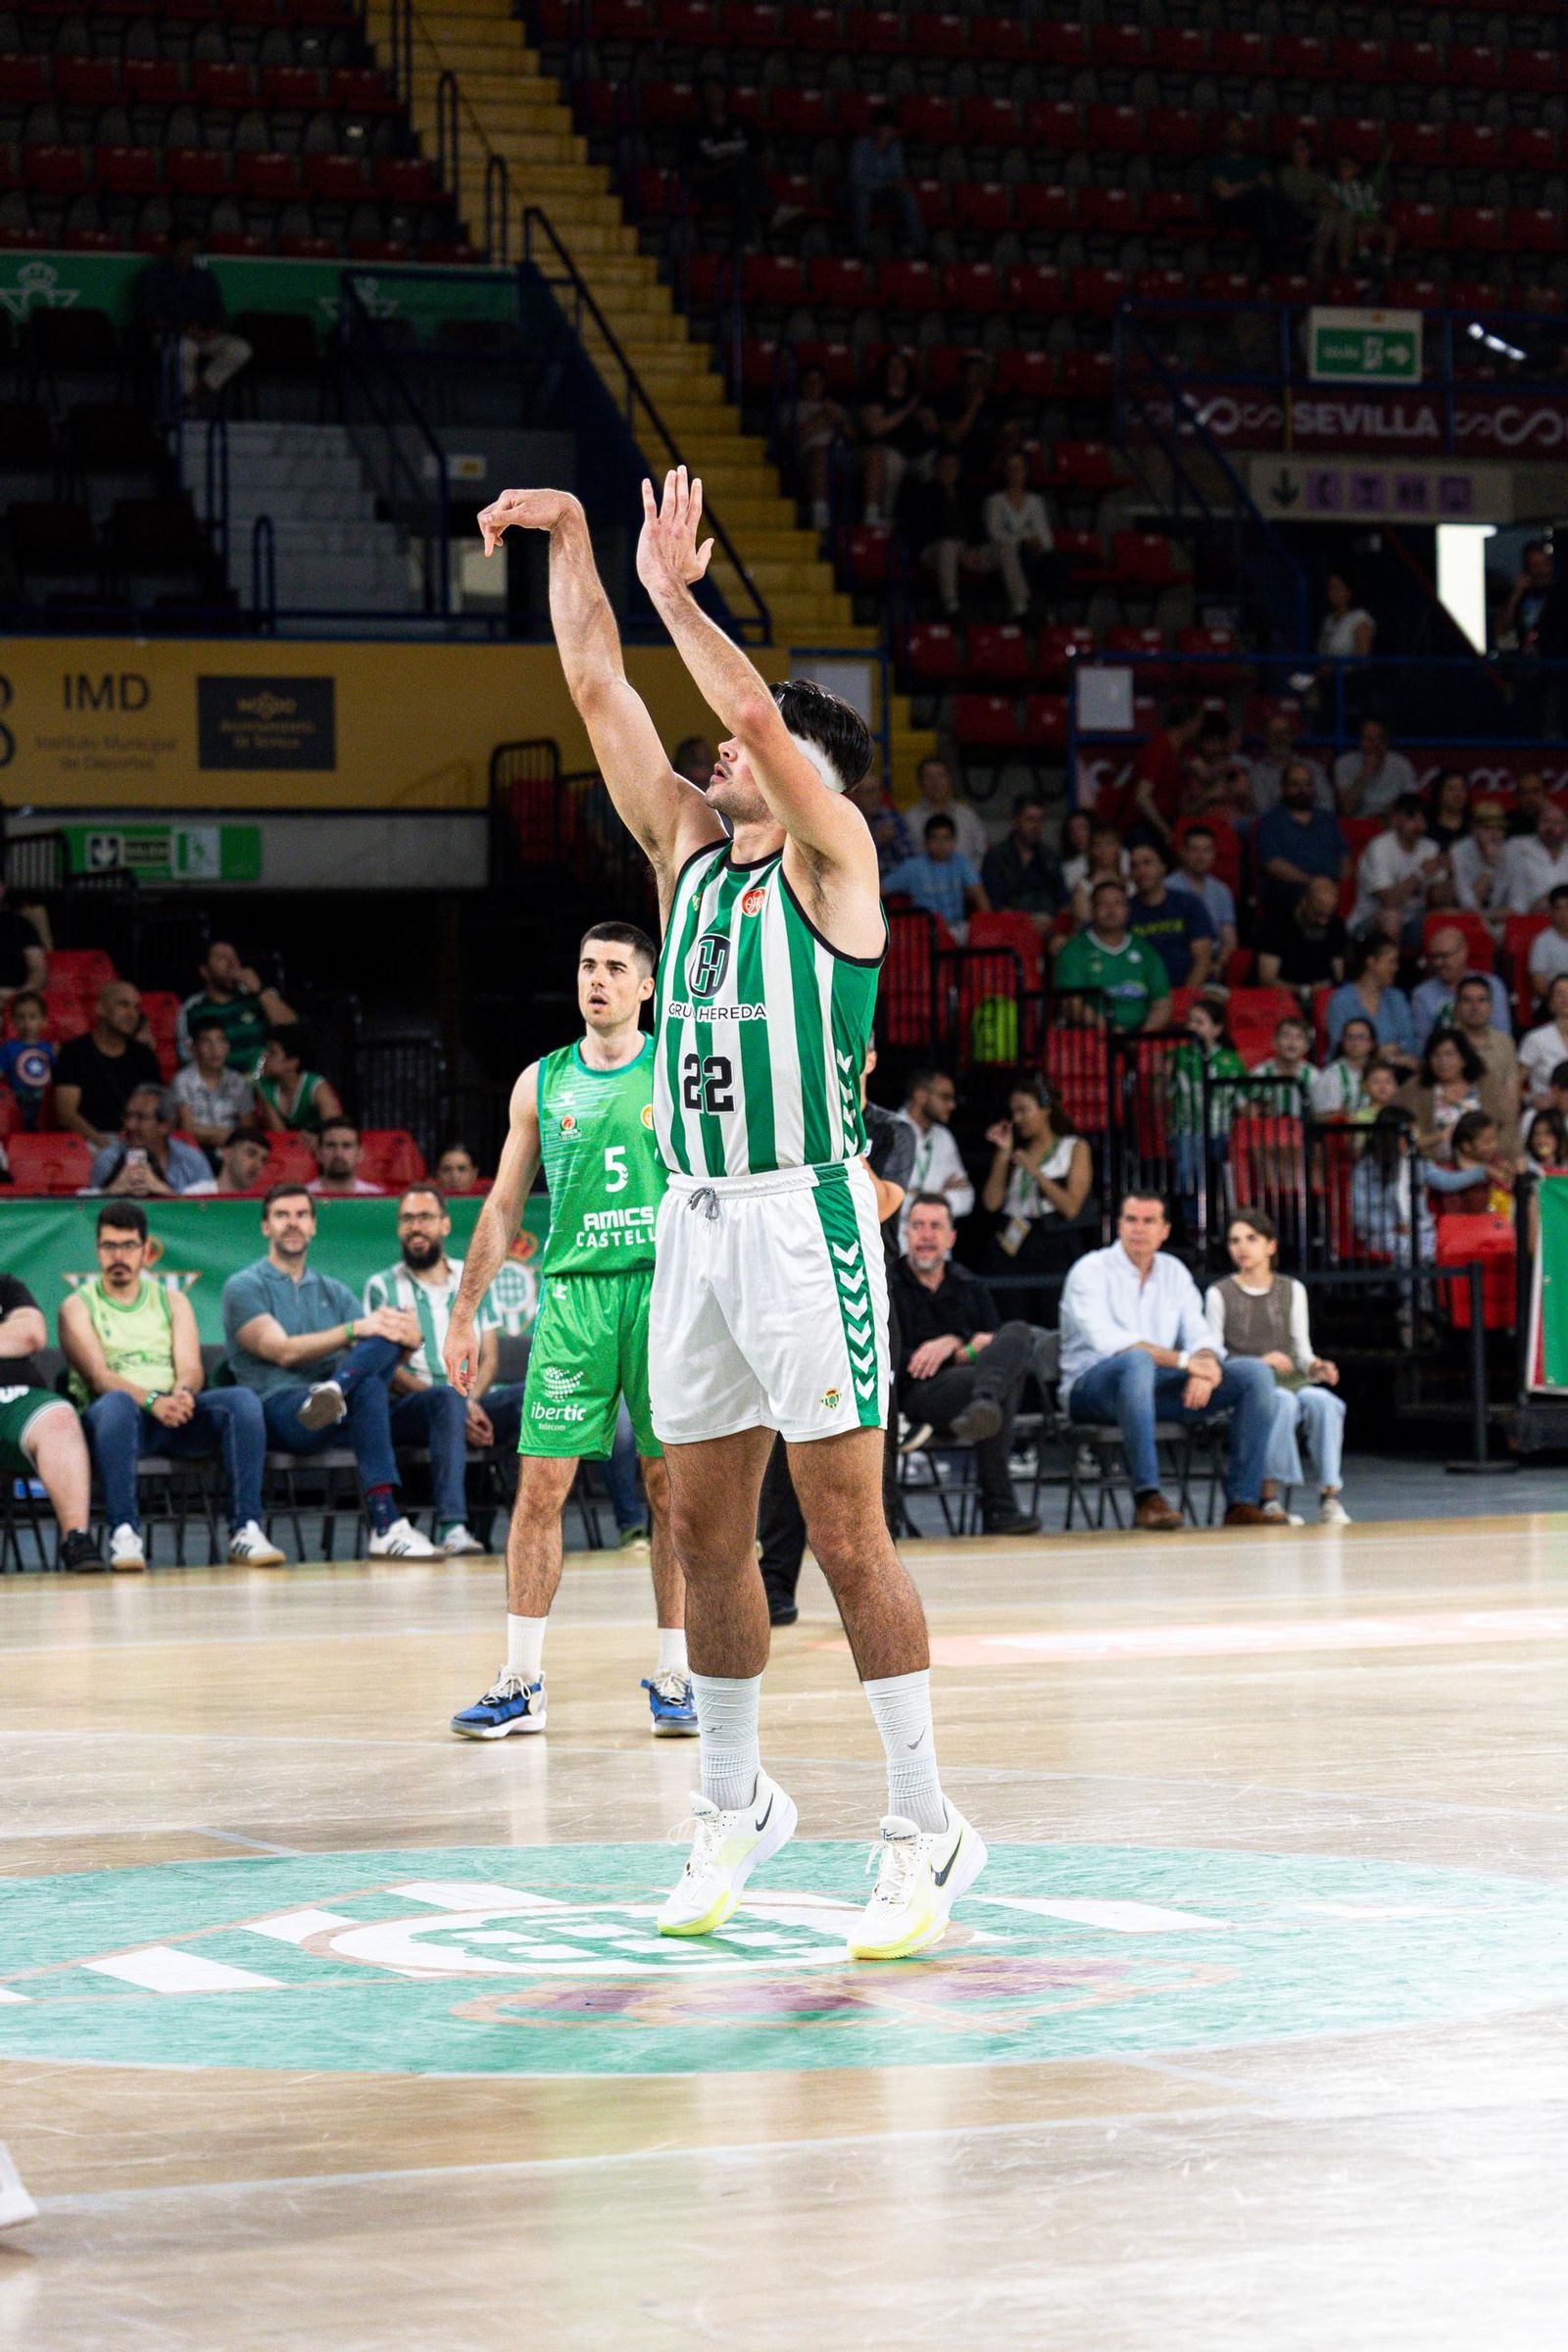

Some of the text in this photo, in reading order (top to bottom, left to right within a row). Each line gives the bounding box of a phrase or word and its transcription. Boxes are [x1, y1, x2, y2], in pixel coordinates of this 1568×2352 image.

[1294, 402, 1440, 438] SEVILLA
[63, 673, 151, 710] IMD
[699, 1004, 767, 1020] HEREDA
[683, 1053, 735, 1112] 22
[604, 1145, 629, 1193] 5
[582, 1205, 655, 1232] AMICS
[575, 1226, 657, 1249] CASTELL
[530, 1401, 587, 1422] ibertic
